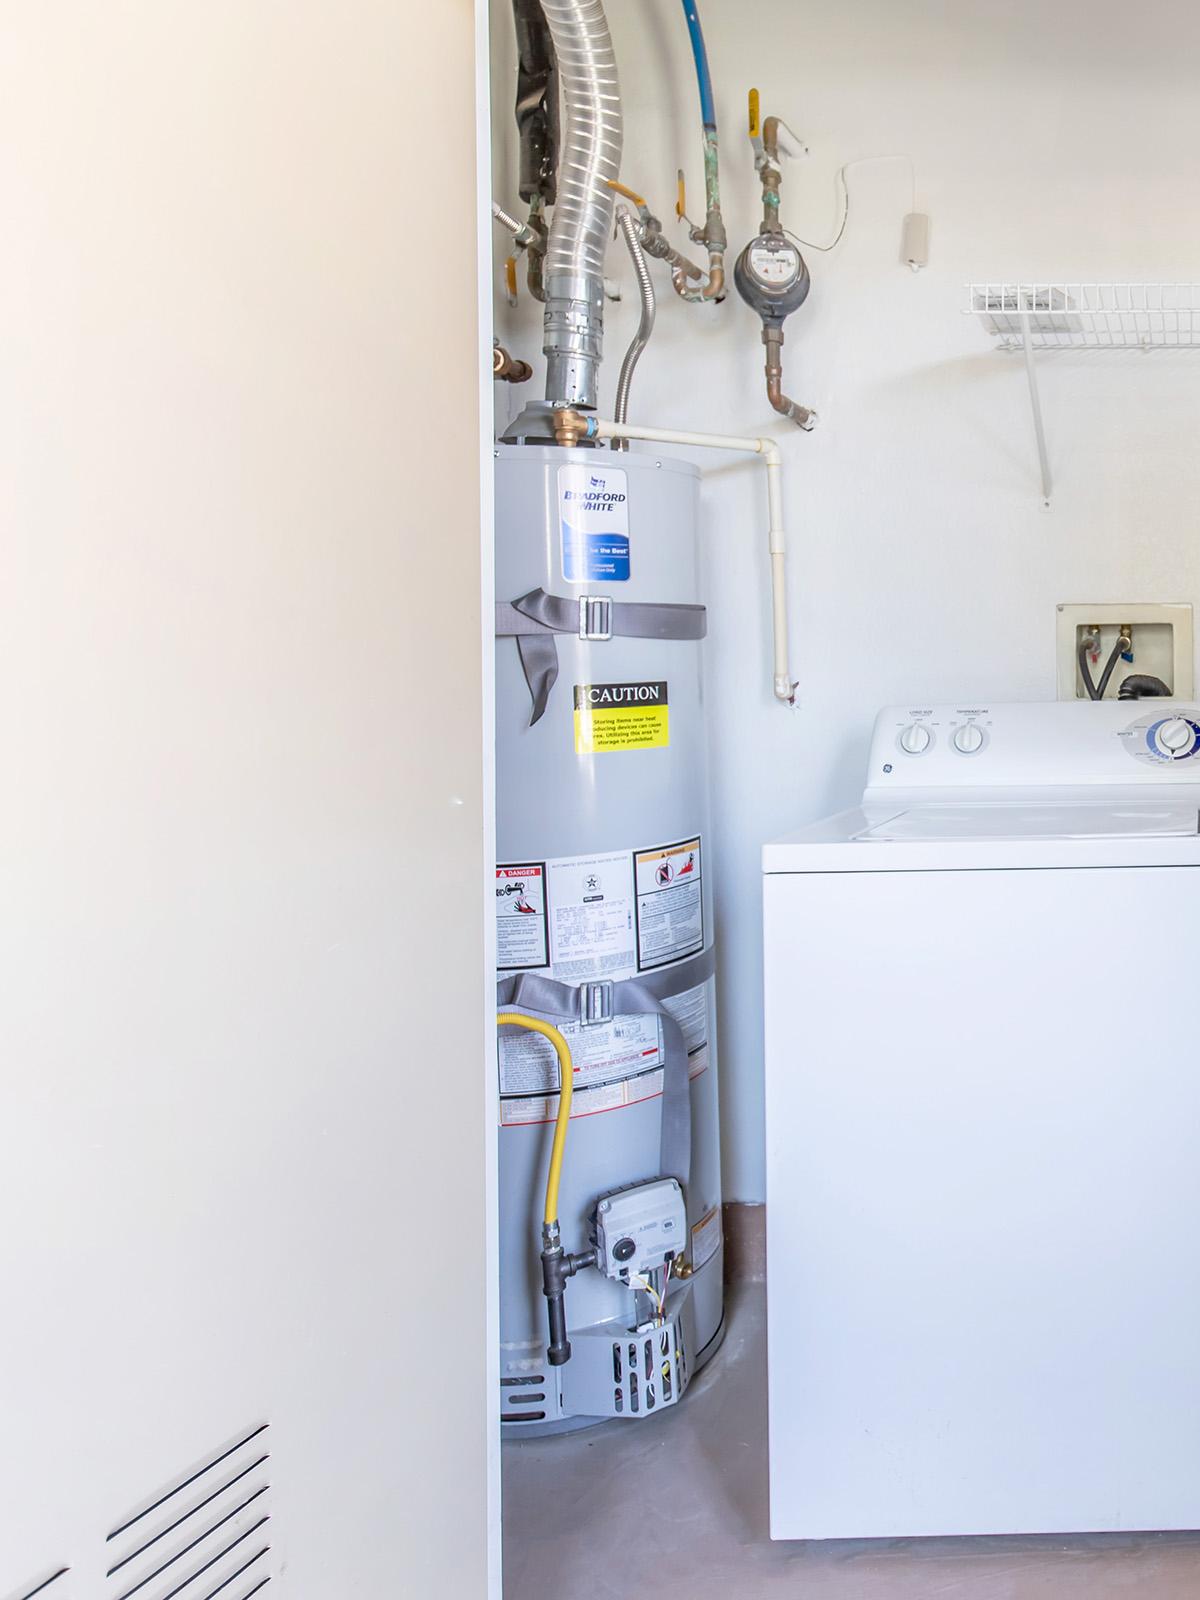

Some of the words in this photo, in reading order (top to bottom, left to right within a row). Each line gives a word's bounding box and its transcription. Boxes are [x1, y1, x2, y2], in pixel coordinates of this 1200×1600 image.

[564, 490, 626, 502] BADFORD
[588, 686, 659, 702] CAUTION
[507, 869, 536, 877] DANGER
